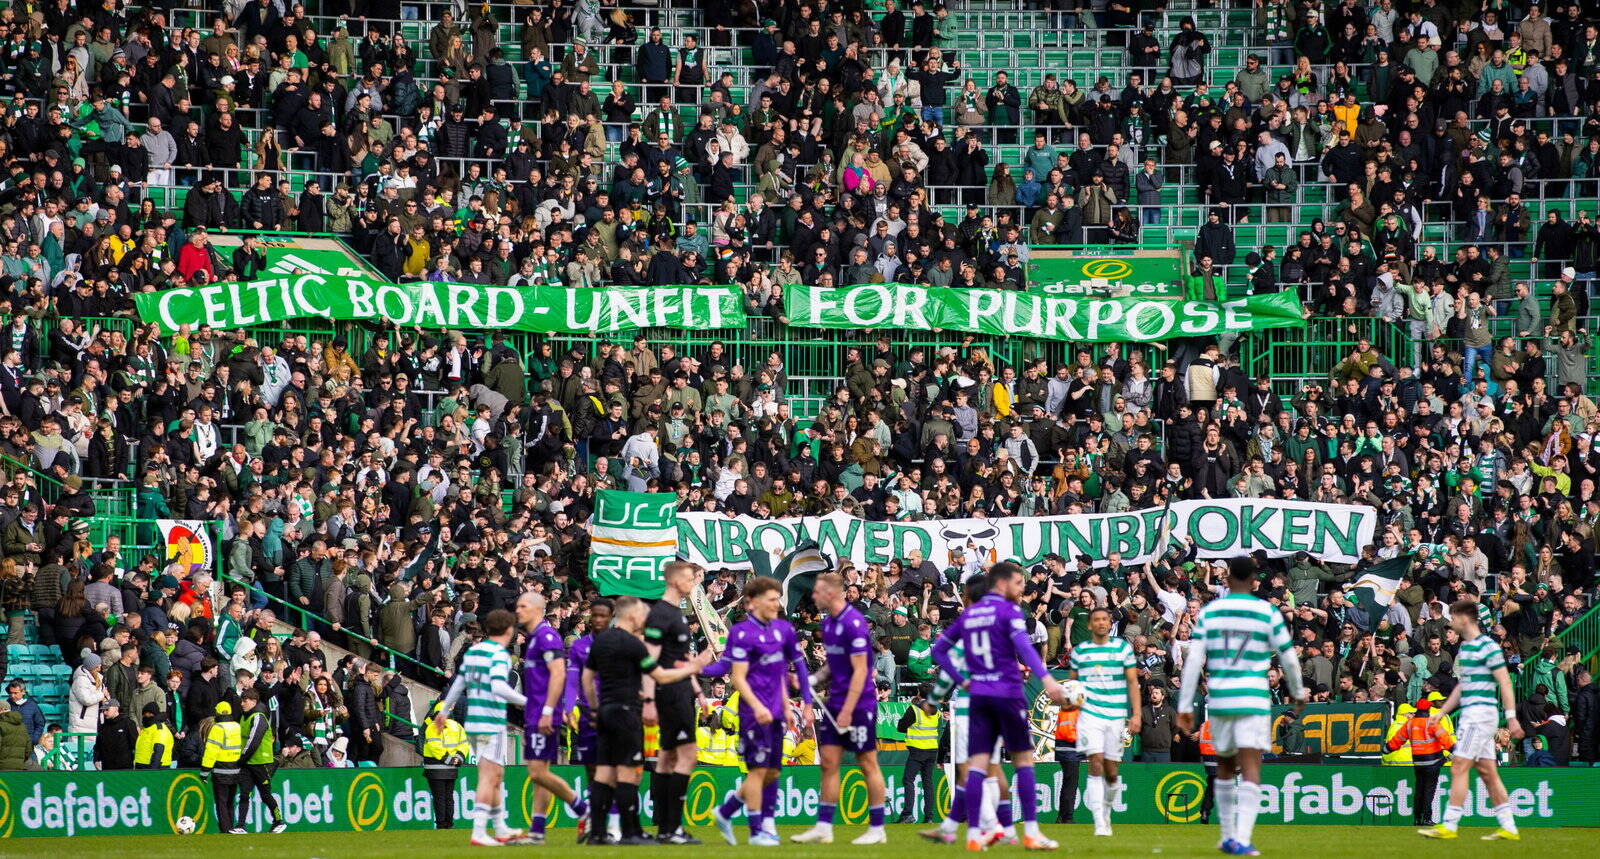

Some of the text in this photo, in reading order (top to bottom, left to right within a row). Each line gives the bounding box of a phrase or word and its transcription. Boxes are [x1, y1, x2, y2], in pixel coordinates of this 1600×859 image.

[158, 274, 331, 332] CELTIC
[346, 279, 524, 328] BOARD
[565, 287, 731, 331] UNFIT
[809, 285, 1253, 340] FOR PURPOSE
[1009, 505, 1364, 568] UNBROKEN
[970, 630, 995, 670] 4
[1221, 629, 1252, 666] 17
[530, 732, 547, 750] 13
[21, 782, 152, 836] dafabet
[1250, 771, 1414, 823] afabet
